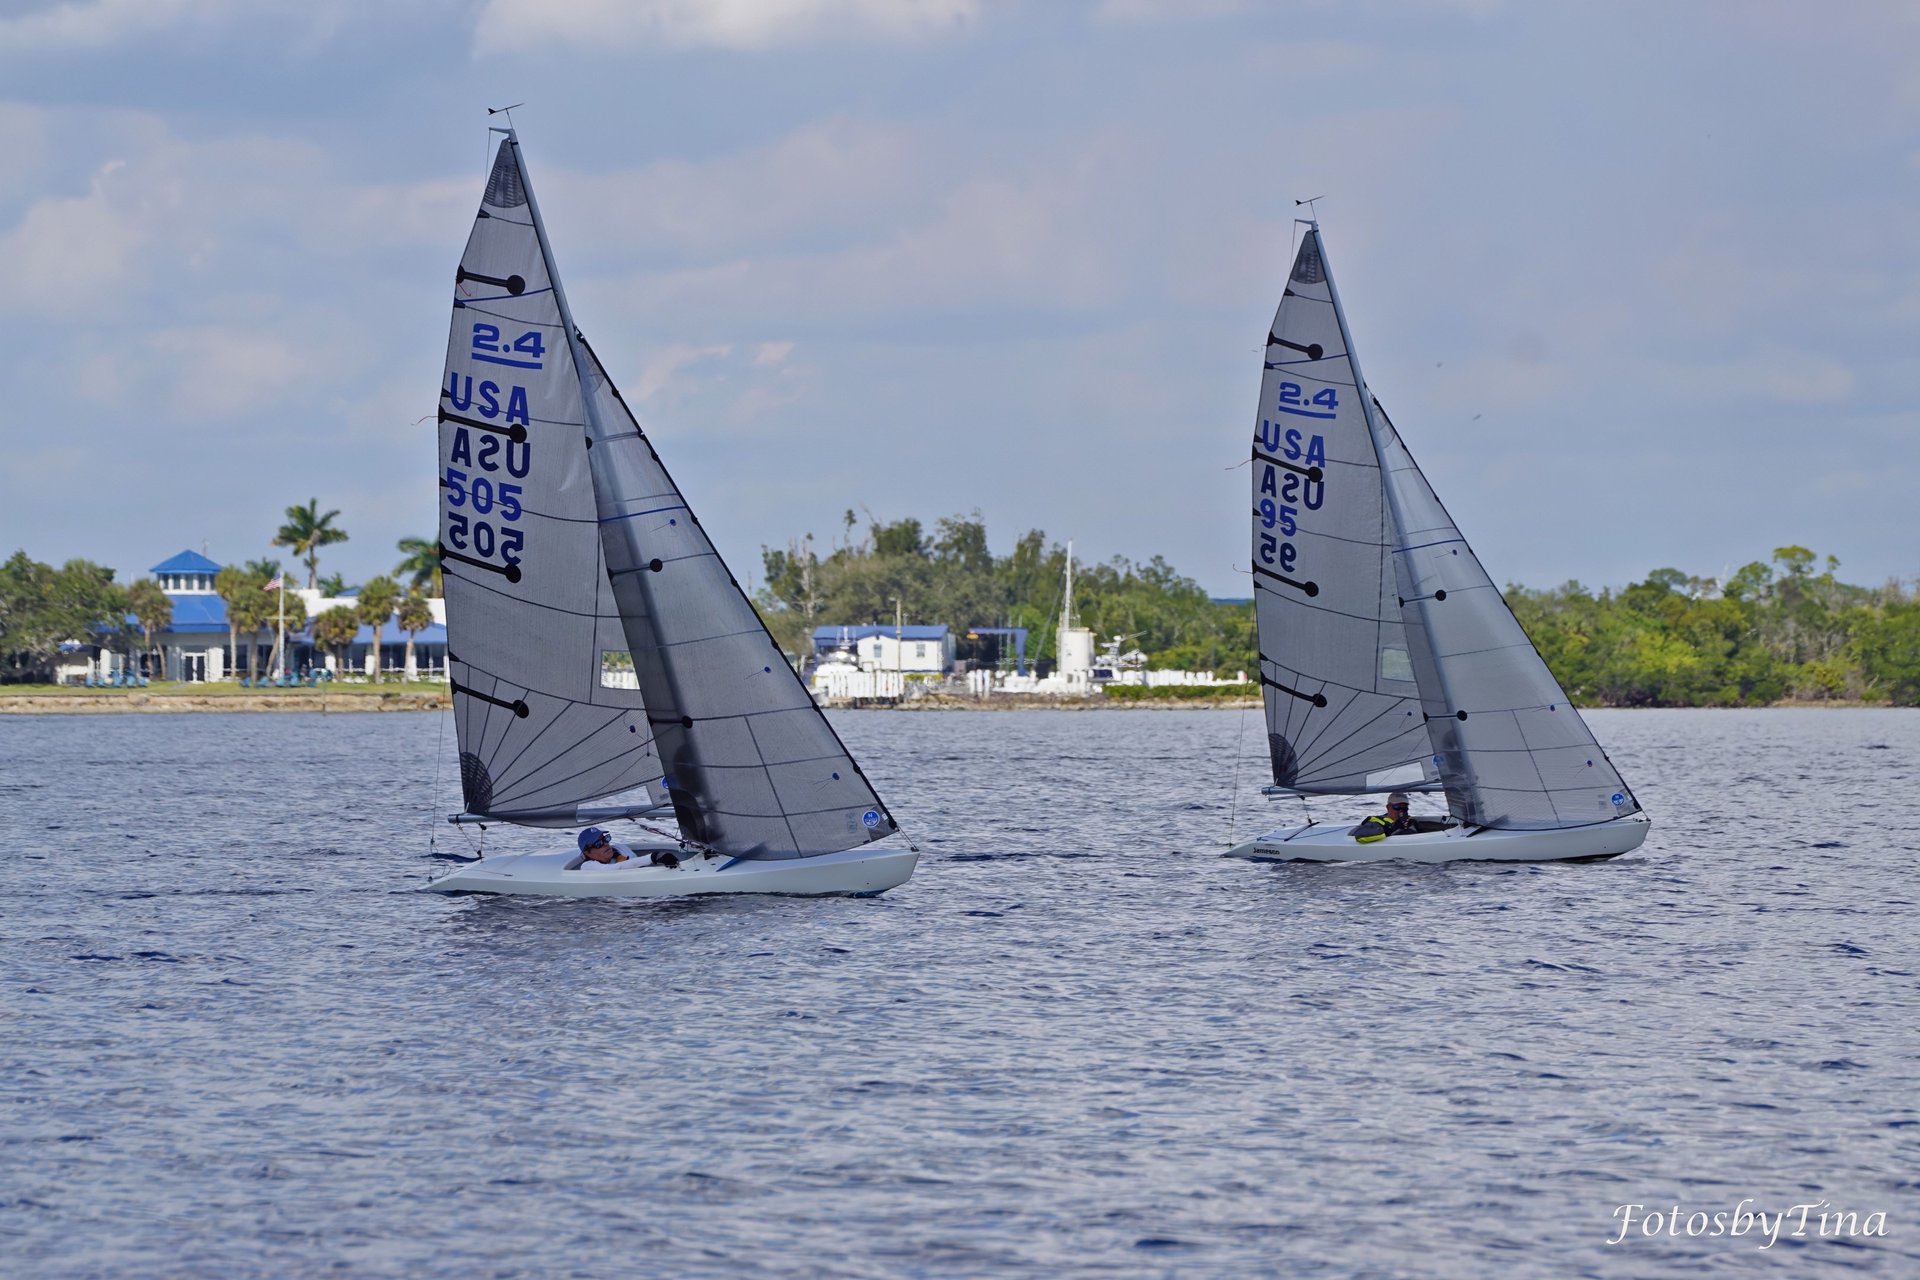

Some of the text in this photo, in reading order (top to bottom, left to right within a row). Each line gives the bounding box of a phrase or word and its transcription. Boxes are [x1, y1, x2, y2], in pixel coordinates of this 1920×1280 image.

[472, 322, 546, 359] 2.4
[450, 371, 530, 426] USA
[1279, 381, 1339, 410] 2.4
[1262, 419, 1326, 468] USA
[446, 466, 523, 522] 505
[1260, 498, 1298, 537] 95
